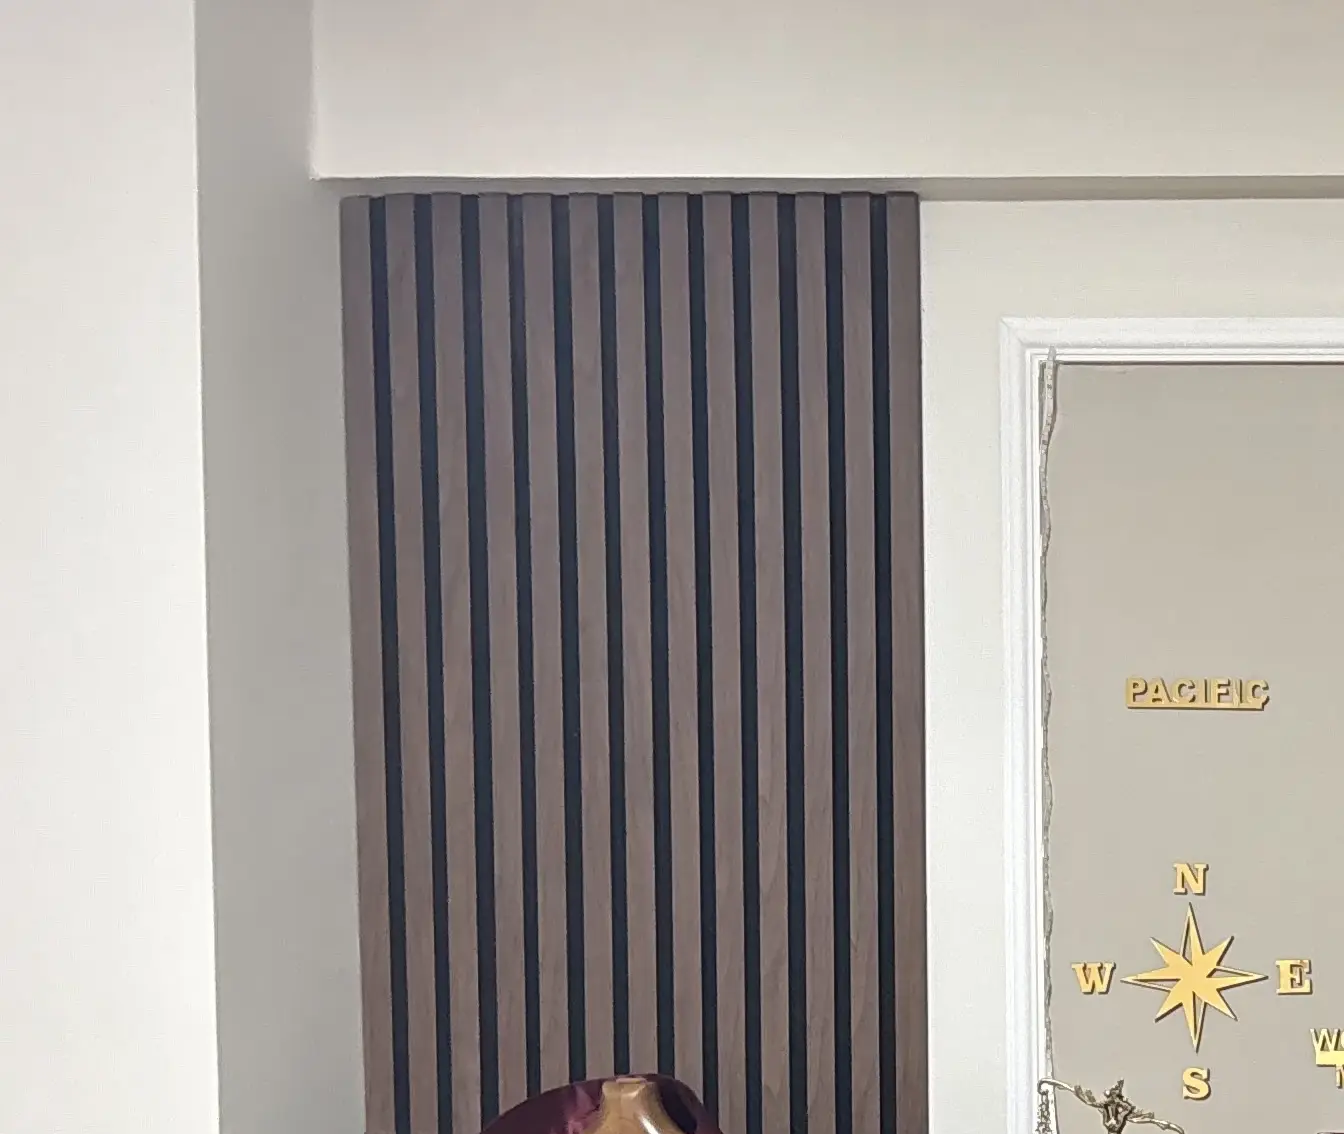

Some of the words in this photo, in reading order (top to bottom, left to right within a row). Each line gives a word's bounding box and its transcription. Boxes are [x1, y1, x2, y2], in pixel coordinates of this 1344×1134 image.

[1126, 676, 1270, 710] PACIFIC
[1173, 863, 1208, 895] N
[1071, 962, 1116, 994] W
[1276, 959, 1312, 994] E
[1182, 1067, 1211, 1099] S
